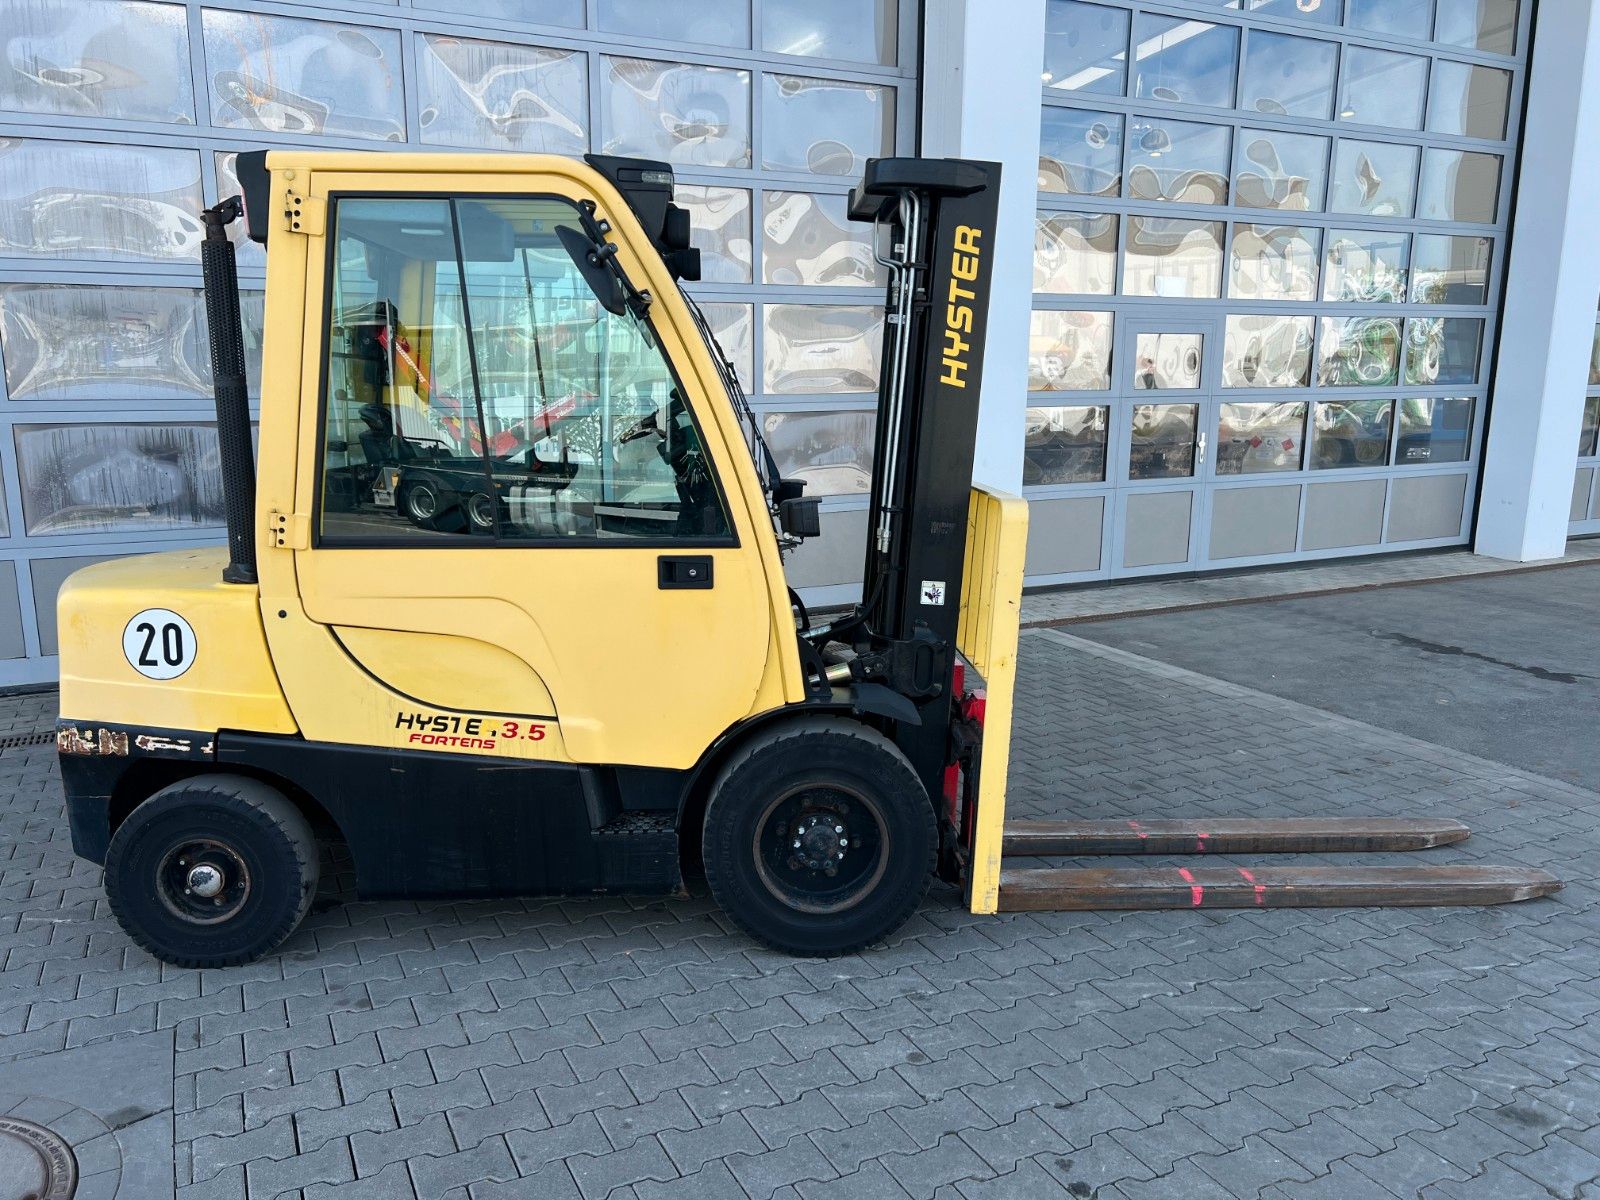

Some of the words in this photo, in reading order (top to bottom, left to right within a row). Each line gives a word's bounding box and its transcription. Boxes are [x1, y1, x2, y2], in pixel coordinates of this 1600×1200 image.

[939, 225, 982, 388] HYSTER
[136, 622, 184, 667] 20
[395, 712, 496, 737] HYSTE
[501, 721, 546, 741] 3.5
[409, 733, 496, 750] FORTENS
